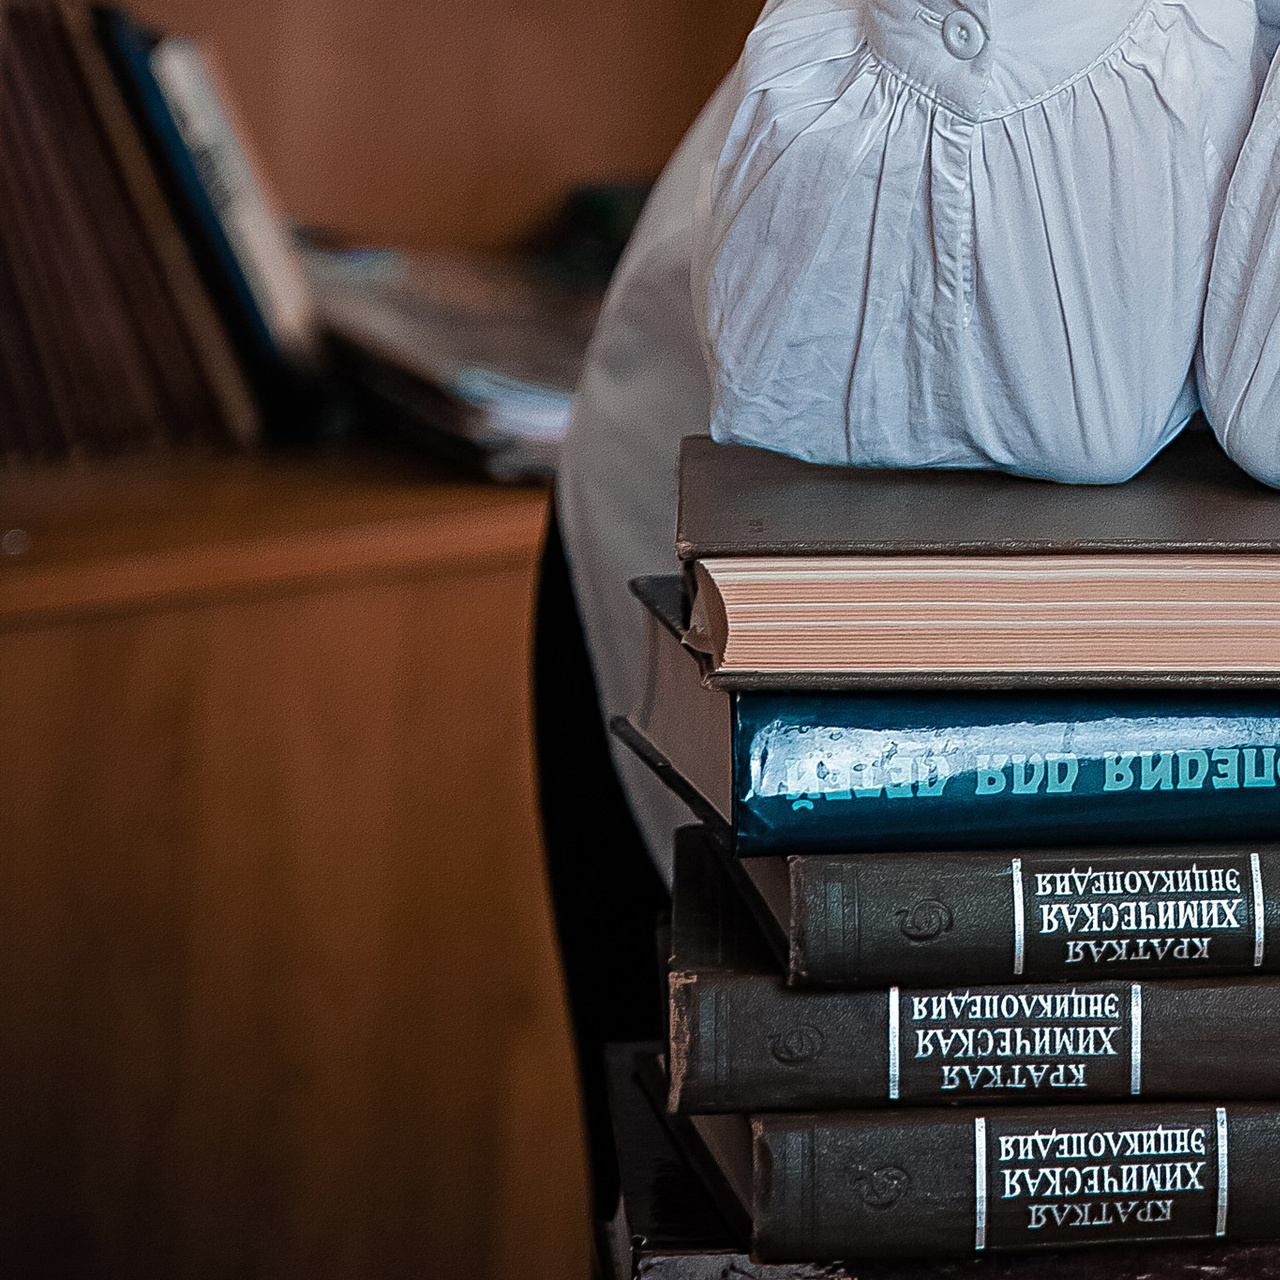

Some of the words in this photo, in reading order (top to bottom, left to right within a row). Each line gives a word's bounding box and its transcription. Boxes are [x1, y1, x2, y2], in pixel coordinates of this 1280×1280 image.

[975, 753, 1078, 794] ДЛЯ
[1035, 863, 1241, 896] ЭНЦИКЛОПЕДИЯ
[1039, 899, 1242, 934] ХИМИЧЕСКАЯ
[1065, 937, 1212, 963] КРАТКАЯ
[911, 987, 1120, 1021] ЭНЦИКЛОПЕДИЯ
[914, 1026, 1122, 1059] ХИМИЧЕСКАЯ
[940, 1064, 1088, 1090] КРАТКАЯ
[998, 1124, 1206, 1161] ЭНЦИКЛОПЕДИЯ
[1001, 1162, 1206, 1199] ХИМИЧЕСКАЯ
[1027, 1199, 1174, 1229] КРАТКАЯ
